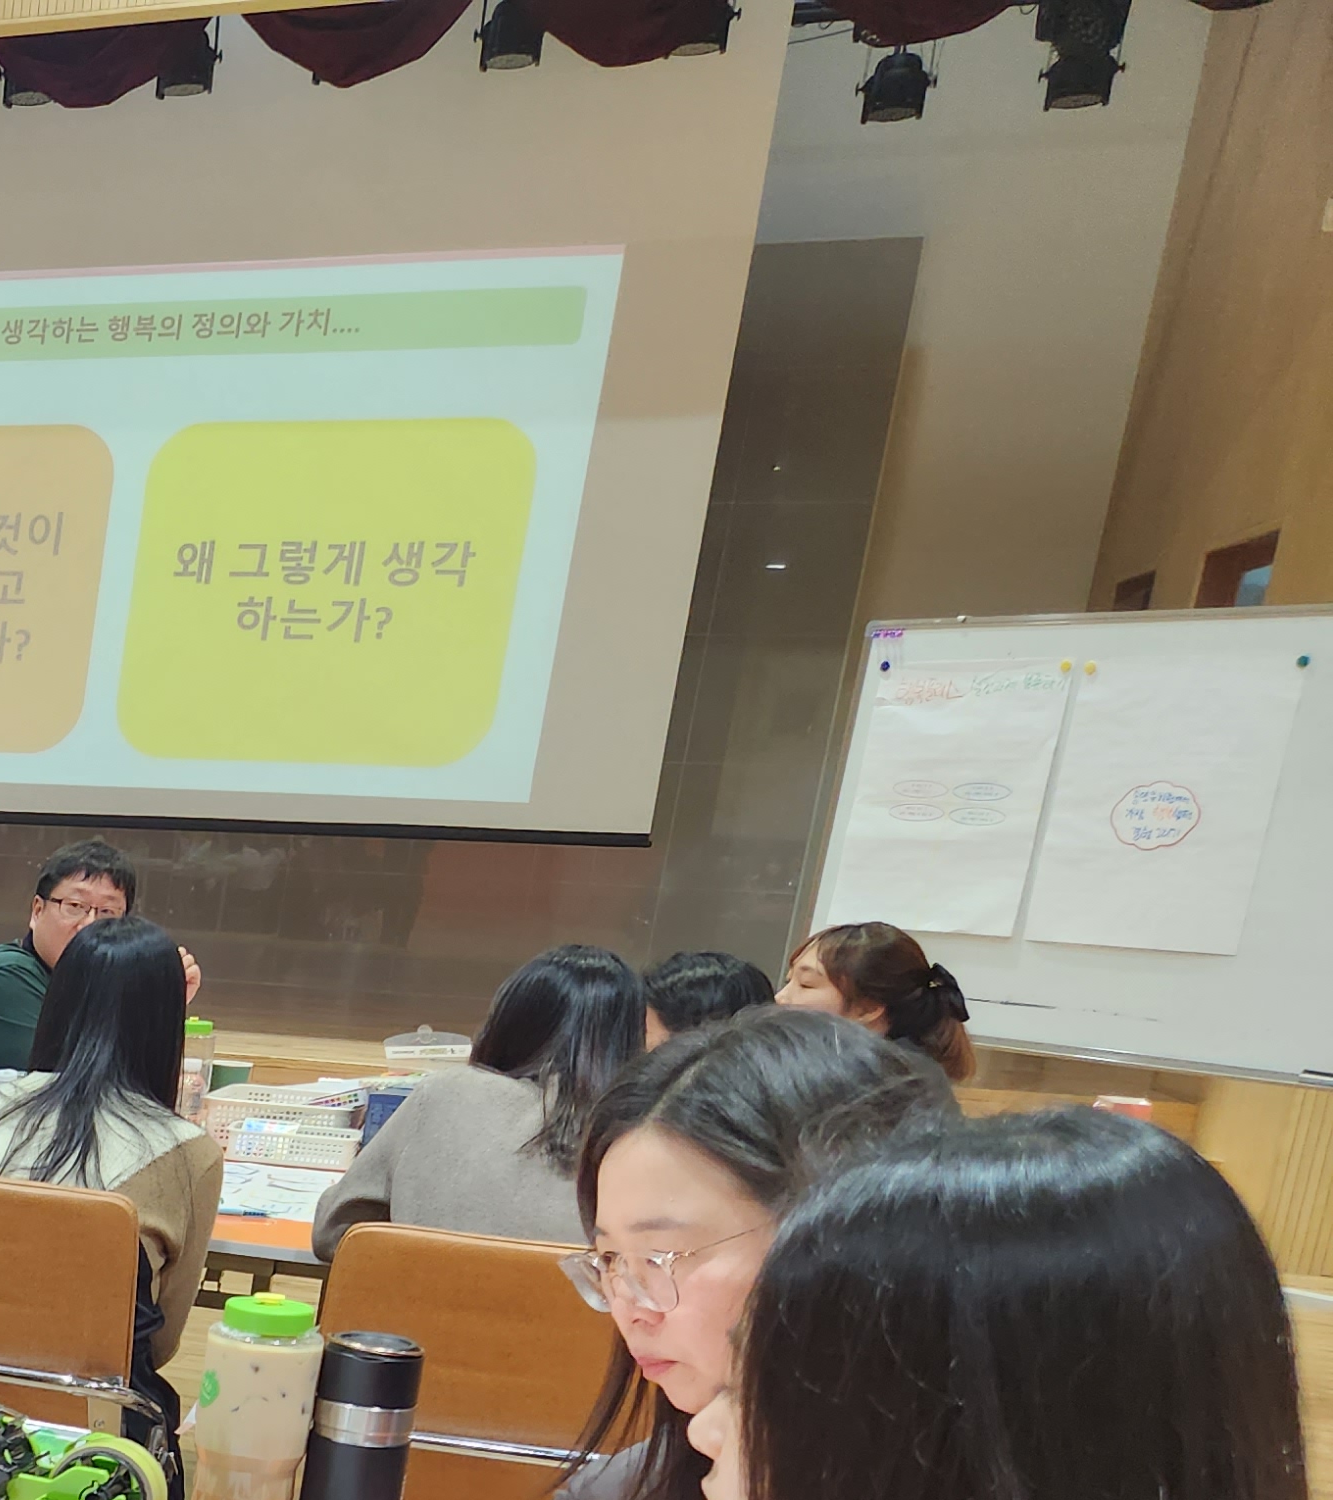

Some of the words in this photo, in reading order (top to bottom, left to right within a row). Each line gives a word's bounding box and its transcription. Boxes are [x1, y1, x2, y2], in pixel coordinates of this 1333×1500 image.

[1, 317, 99, 345] 생각하는
[107, 314, 183, 342] 행복의
[191, 310, 269, 340] 정의와
[173, 539, 215, 585] 왜
[228, 540, 366, 587] 그렇게
[381, 540, 476, 588] 생각
[236, 596, 394, 643] 하는가?
